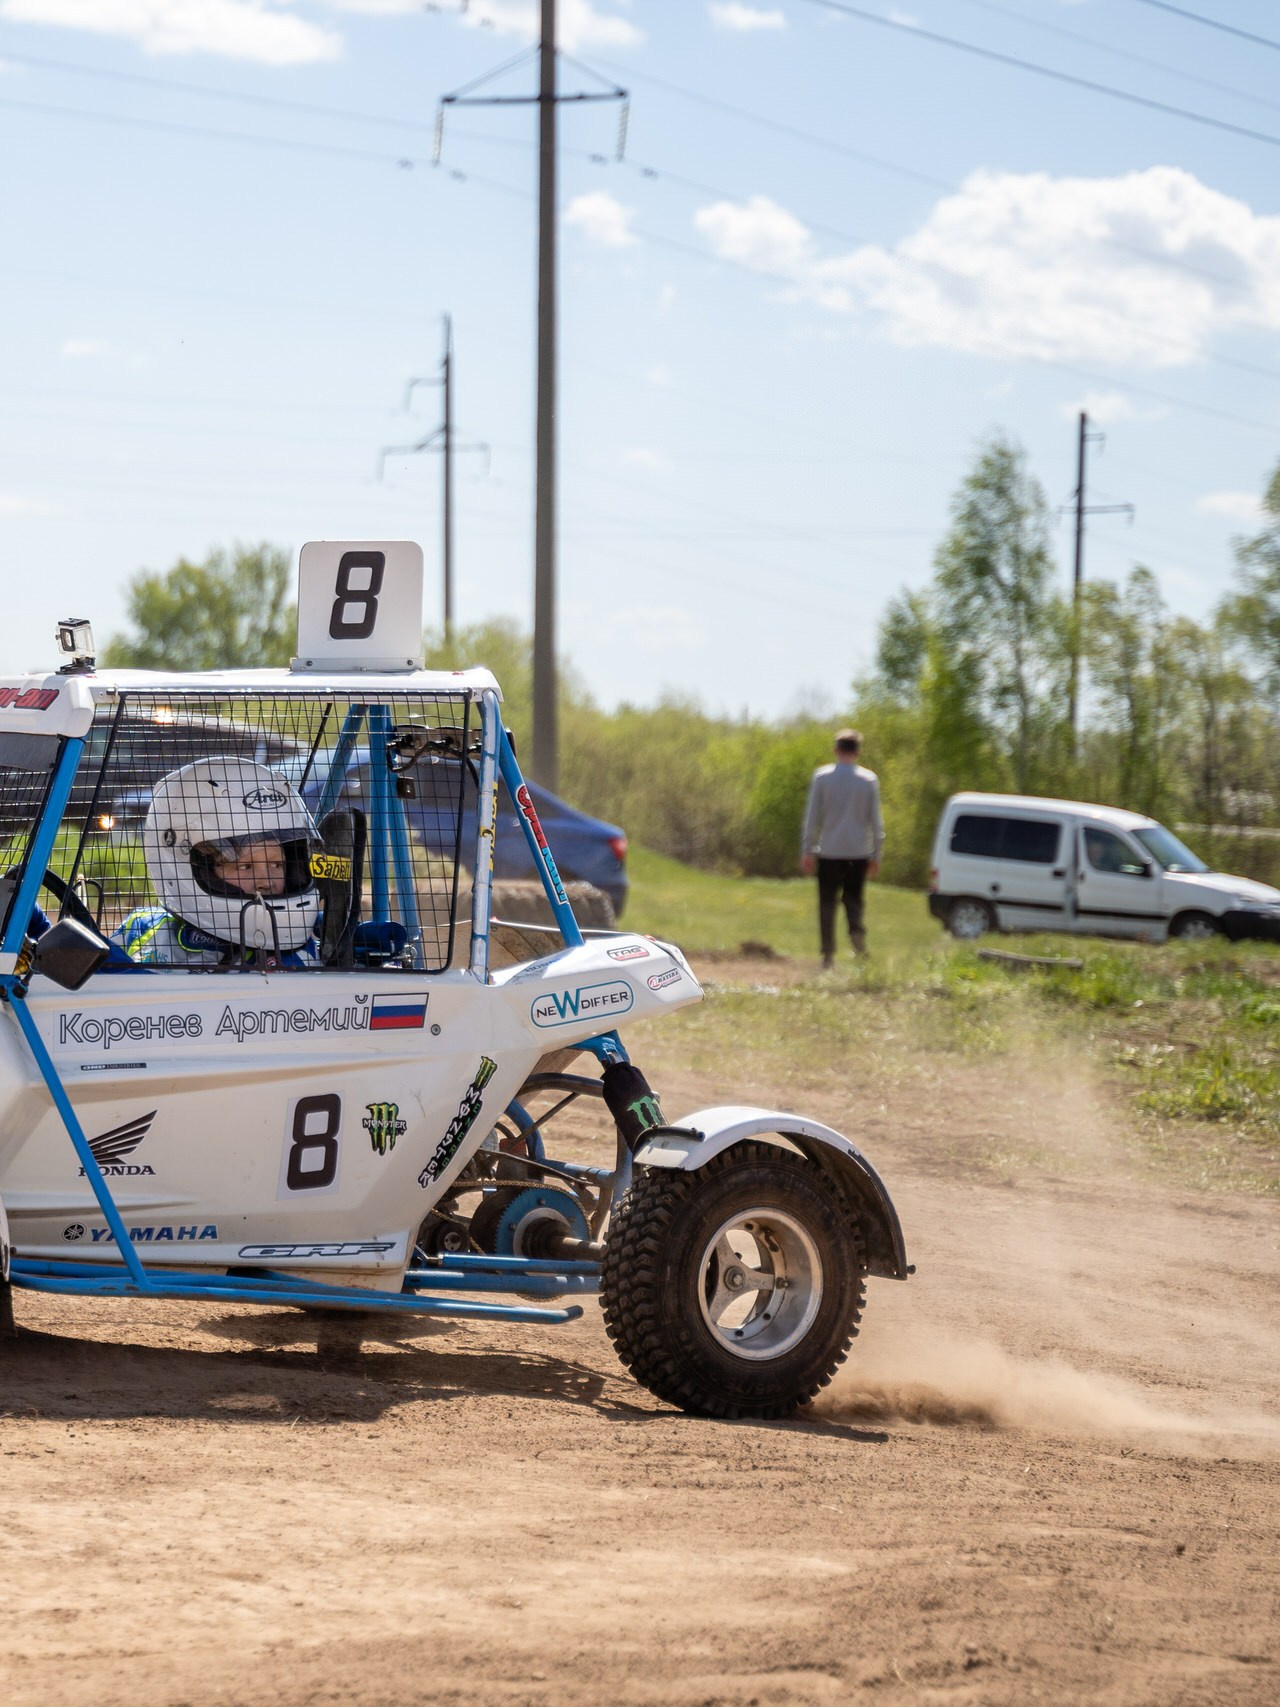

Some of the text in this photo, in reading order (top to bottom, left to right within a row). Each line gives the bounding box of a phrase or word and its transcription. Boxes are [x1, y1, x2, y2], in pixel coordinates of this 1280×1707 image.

[329, 551, 386, 640] 8
[60, 994, 370, 1049] Коренев Артемий
[536, 988, 629, 1019] NEWDIFFER
[286, 1093, 341, 1190] 8
